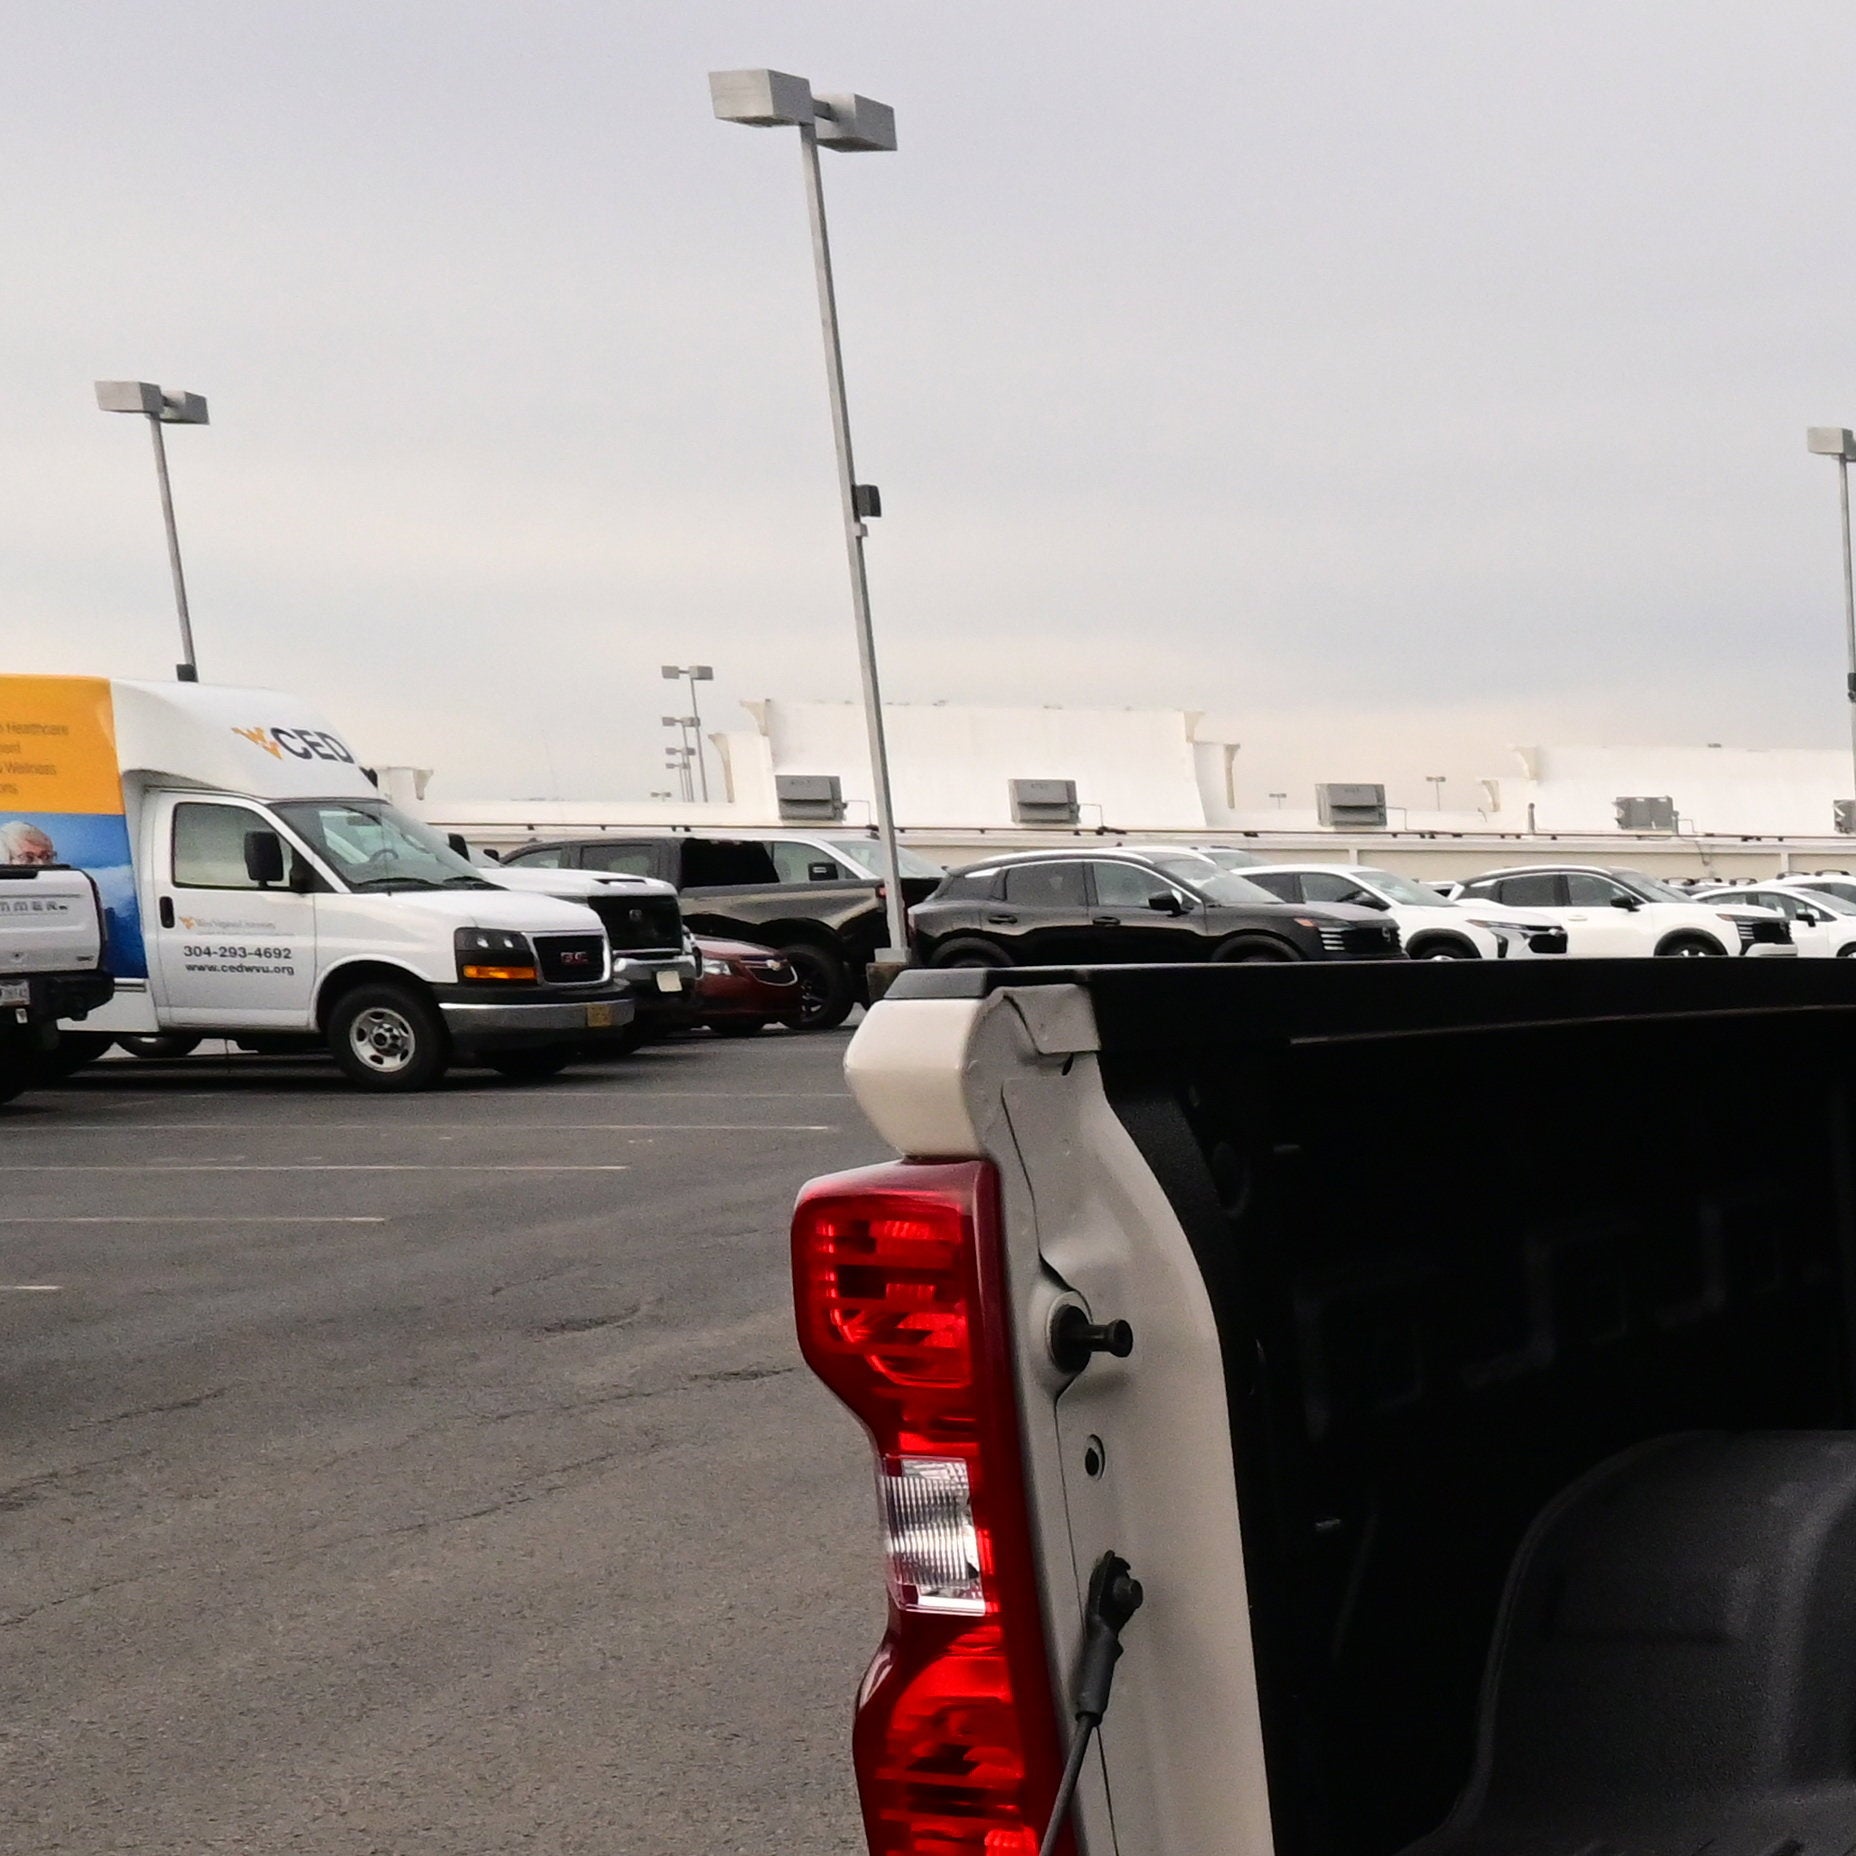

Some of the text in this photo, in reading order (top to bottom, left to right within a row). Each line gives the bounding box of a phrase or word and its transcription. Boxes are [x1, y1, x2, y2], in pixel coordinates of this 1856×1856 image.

[270, 727, 355, 764] CED
[184, 945, 292, 960] 304-293-4692
[185, 963, 295, 976] www.cedwvu.org
